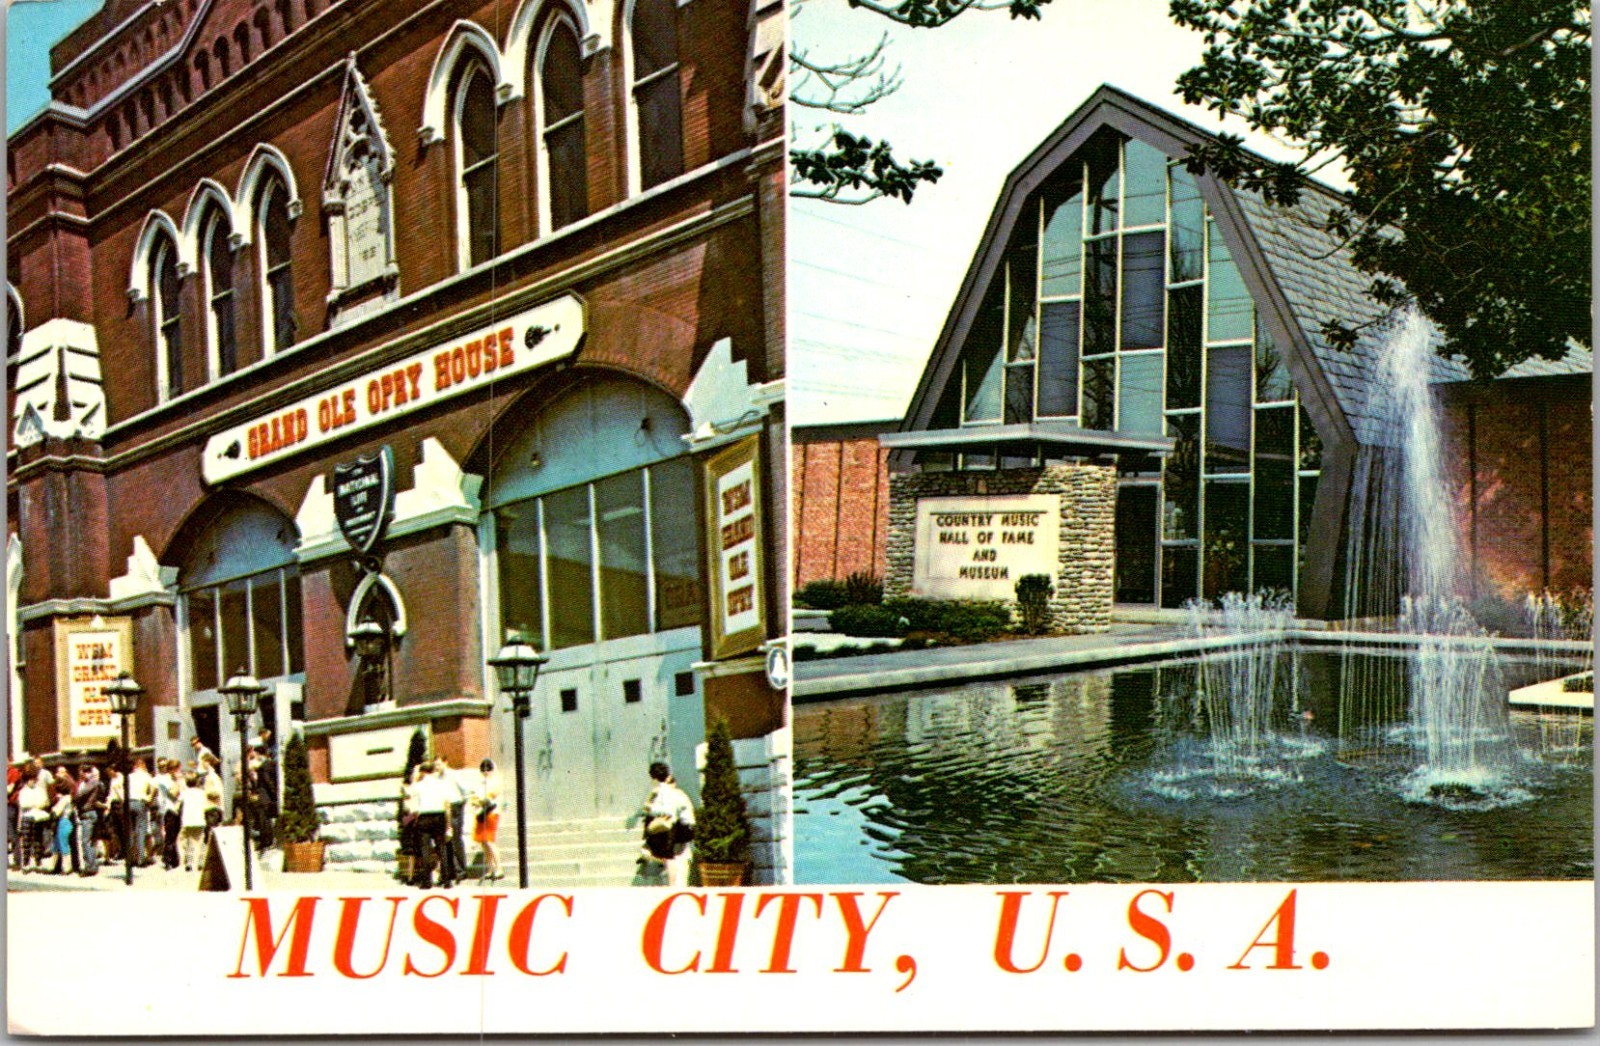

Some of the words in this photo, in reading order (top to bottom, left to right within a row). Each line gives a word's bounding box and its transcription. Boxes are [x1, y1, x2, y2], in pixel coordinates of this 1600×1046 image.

[247, 408, 308, 460] GRAND
[318, 388, 356, 433] OLE
[367, 361, 422, 415] OPRY
[434, 326, 515, 392] HOUSE
[936, 514, 993, 527] COUNTRY
[1001, 514, 1040, 527] MUSIC
[939, 530, 969, 544] HALL
[977, 530, 994, 544] OF
[1002, 530, 1035, 544] FAME
[973, 548, 998, 562] AND
[728, 551, 749, 582] OLE
[959, 565, 1010, 579] MUSEUM
[727, 584, 754, 616] OPRY
[79, 708, 112, 726] OPRY
